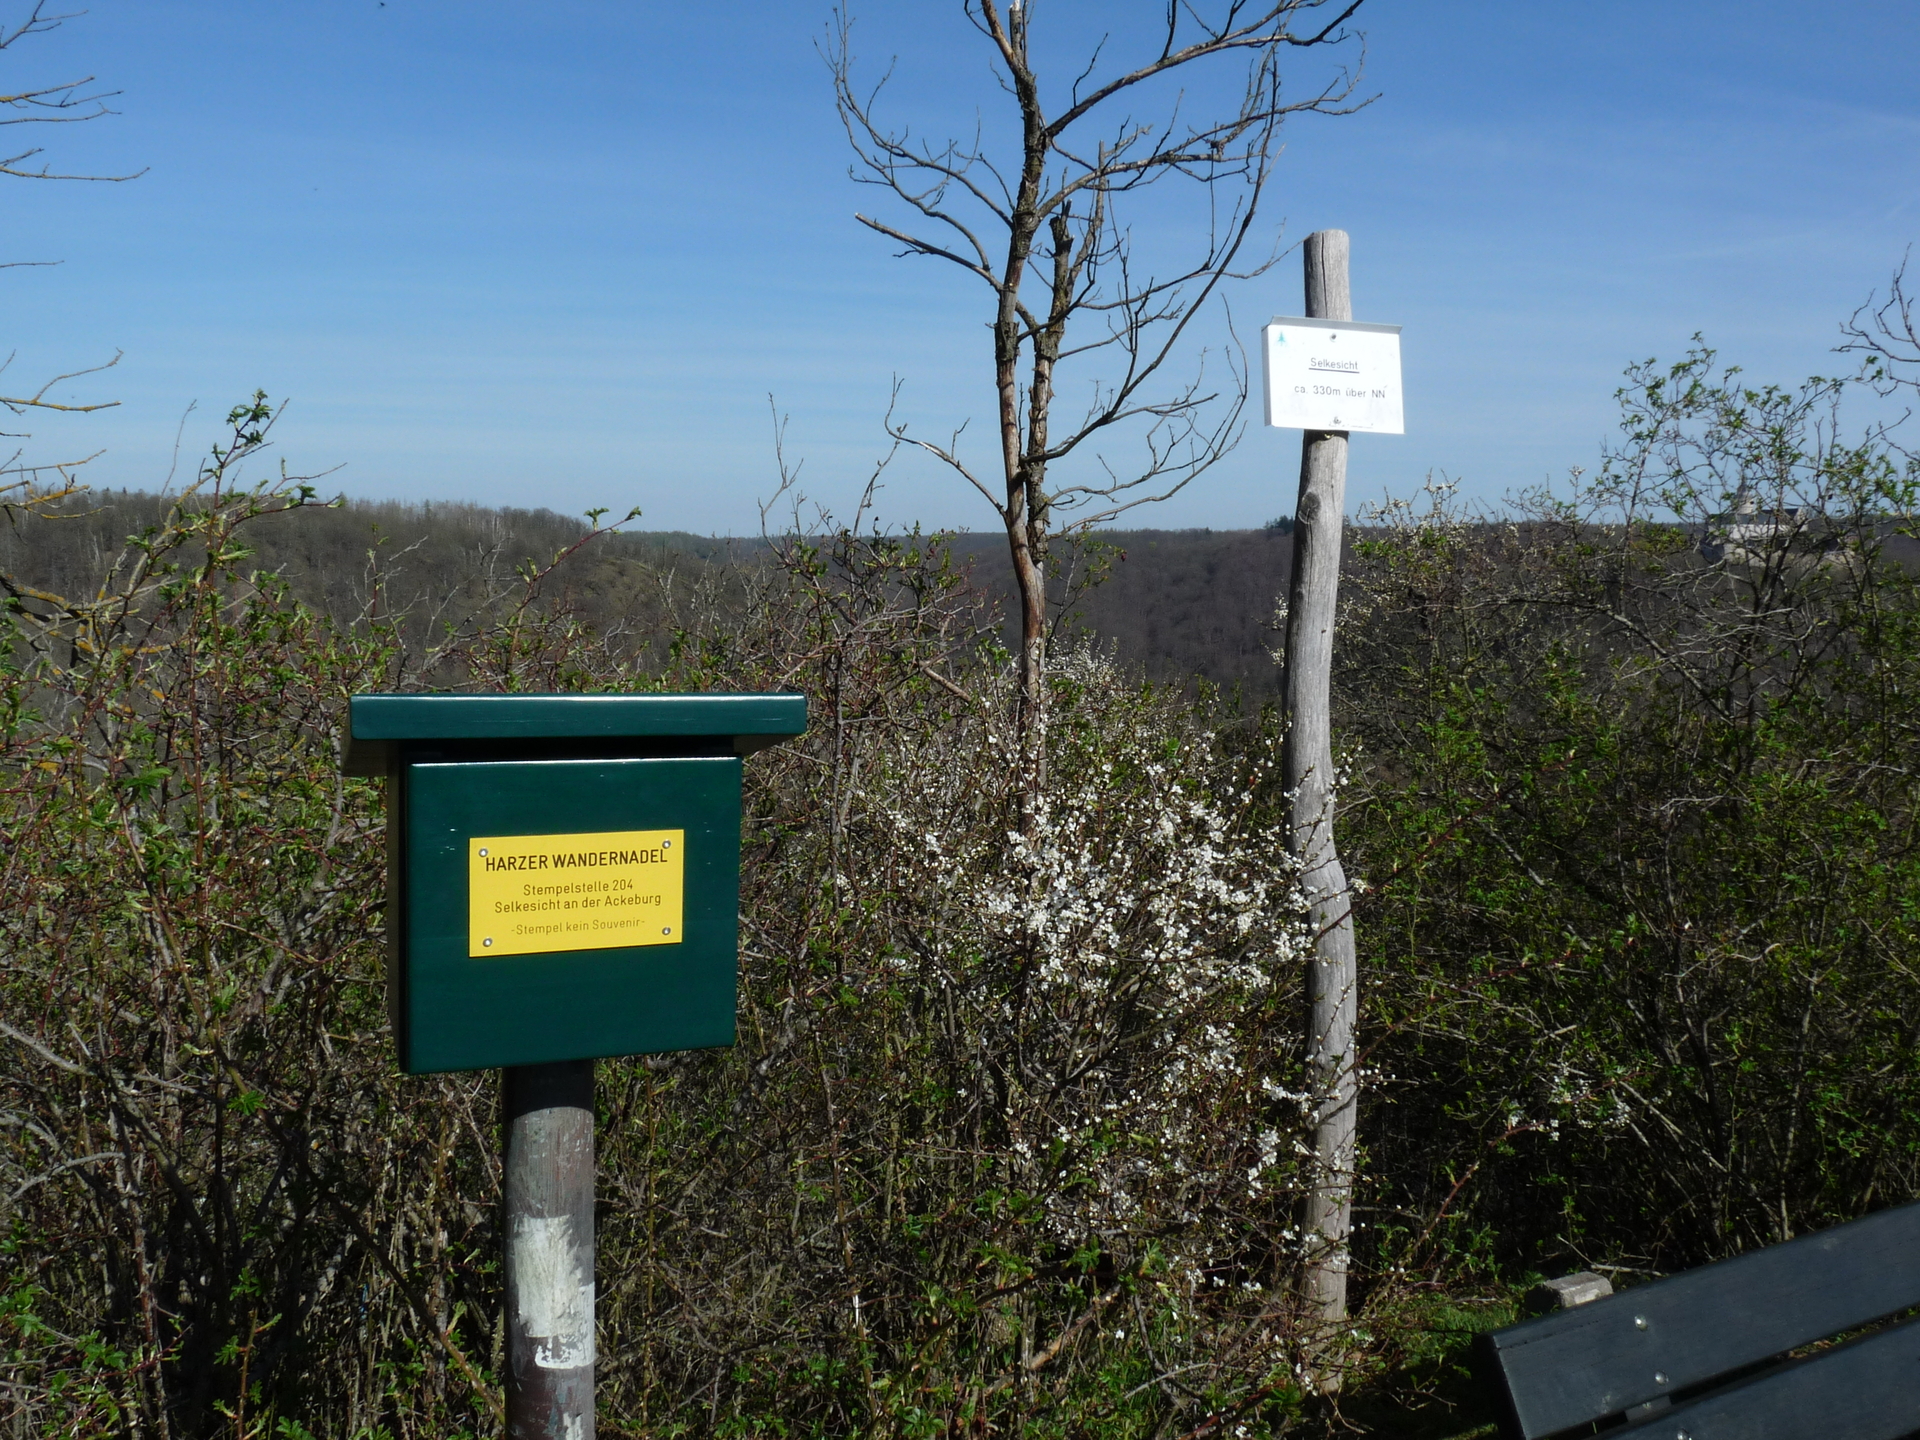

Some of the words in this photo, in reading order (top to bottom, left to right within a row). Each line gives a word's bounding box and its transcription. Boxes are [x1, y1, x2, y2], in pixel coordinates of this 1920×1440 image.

[1310, 357, 1358, 370] Selkesicht
[1313, 385, 1341, 396] 330m
[1345, 387, 1366, 398] über
[1371, 389, 1386, 399] NN
[485, 855, 549, 872] HARZER
[552, 849, 668, 869] WANDERNADEL
[523, 880, 609, 897] Stempelstelle
[612, 878, 634, 891] 204
[494, 898, 561, 914] Selkesicht
[563, 899, 578, 909] an
[581, 896, 602, 909] der
[604, 893, 661, 907] Ackeburg
[566, 920, 589, 932] kein
